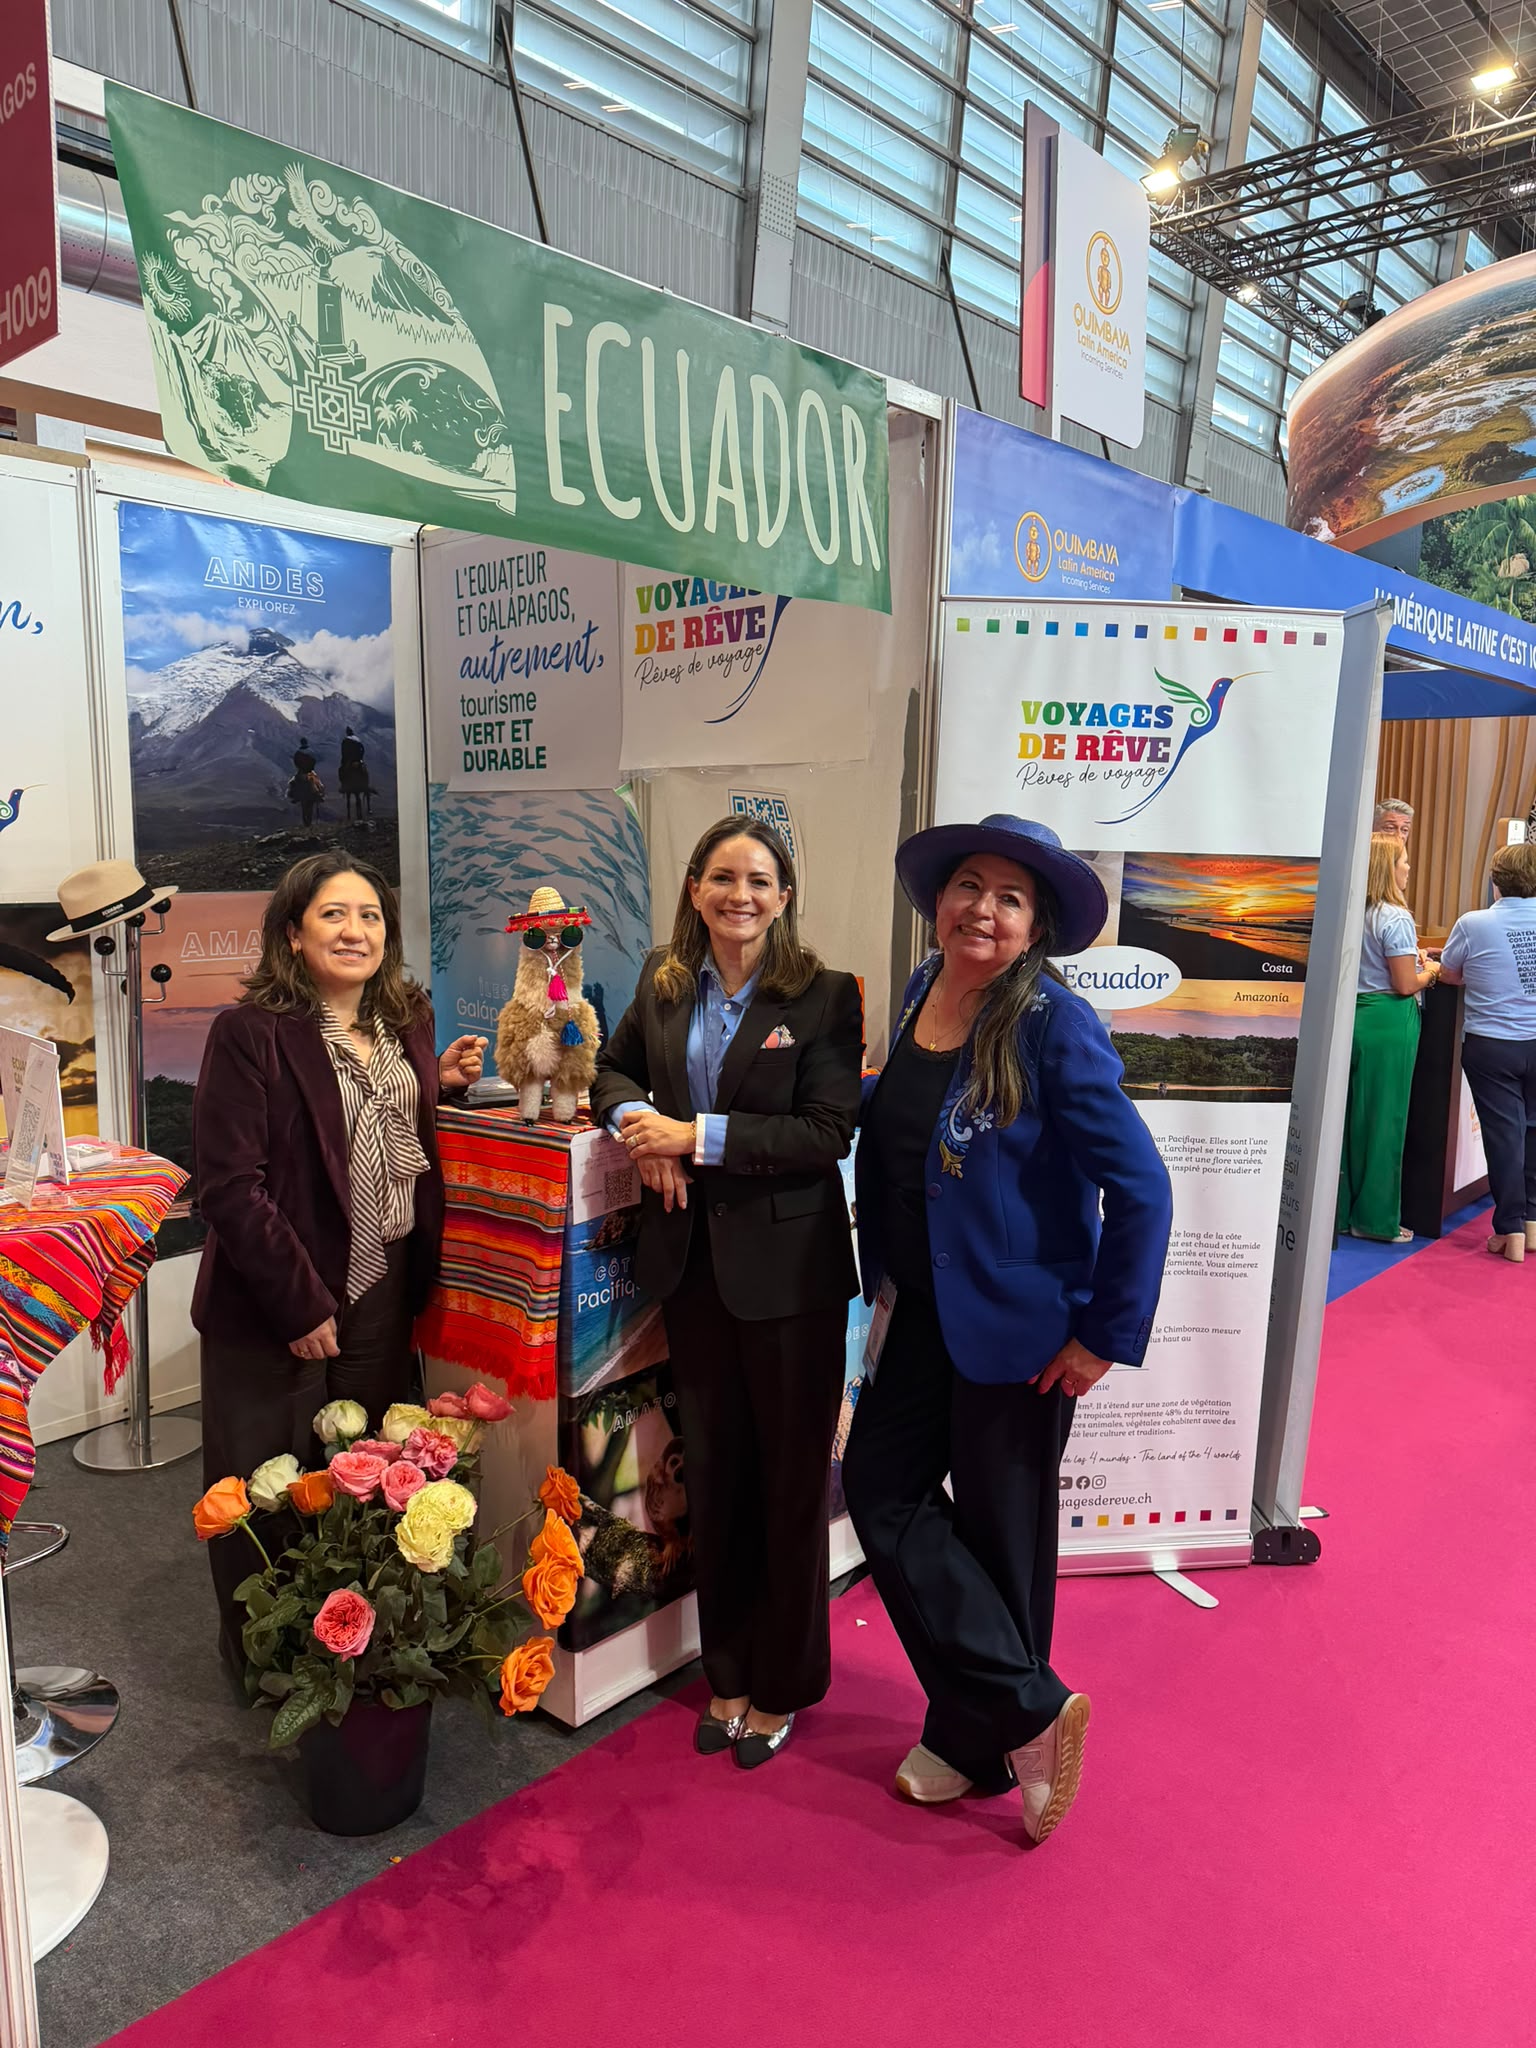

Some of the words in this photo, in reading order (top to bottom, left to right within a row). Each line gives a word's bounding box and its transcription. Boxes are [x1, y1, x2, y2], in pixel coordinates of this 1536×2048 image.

[1073, 302, 1132, 355] QUIMBAYA
[1077, 329, 1095, 351] Latin
[1096, 341, 1128, 369] America
[543, 302, 881, 571] ECUADOR
[1053, 529, 1119, 567] QUIMBAYA
[204, 556, 324, 597] ANDES
[456, 551, 547, 599] L'EQUATEUR
[1058, 555, 1078, 573] Latin
[1080, 561, 1115, 583] America
[1061, 574, 1089, 591] Incoming
[1088, 580, 1111, 594] Services
[238, 597, 296, 615] EXPLOREZ
[457, 604, 473, 637] ET
[478, 587, 575, 633] GALÁPAGOS,
[634, 620, 675, 655] DE
[683, 605, 765, 649] RÊVE
[459, 619, 604, 684] autrement,
[1456, 618, 1499, 657] LATINE
[1500, 633, 1527, 666] C'EST
[634, 656, 684, 691] Rêves
[688, 652, 703, 675] de
[707, 644, 765, 678] voyage
[460, 689, 537, 717] tourisme
[1021, 700, 1174, 729] VOYAGES
[461, 721, 505, 746] VERT
[511, 718, 533, 743] ET
[1017, 733, 1066, 760] DE
[1075, 729, 1171, 763] RÊVE
[463, 746, 547, 772] DURABLE
[1016, 762, 1074, 790] Rêves
[1079, 764, 1098, 783] de
[1103, 766, 1168, 790] voyage
[1062, 964, 1169, 990] Ecuador
[1261, 962, 1293, 974] Costa
[1233, 991, 1289, 1003] Amazonía
[1168, 1135, 1207, 1145] Pacifique.
[1209, 1137, 1228, 1145] Elles
[1164, 1145, 1203, 1154] L'archipel
[1216, 1147, 1241, 1155] trouve
[1250, 1148, 1267, 1156] près
[1211, 1156, 1231, 1165] flore
[1172, 1165, 1200, 1173] inspiré
[1202, 1167, 1222, 1175] pour
[1224, 1166, 1252, 1174] étudier
[1183, 1231, 1201, 1240] long
[1215, 1232, 1223, 1240] la
[1194, 1240, 1220, 1249] chaud
[1231, 1242, 1261, 1250] humide
[1206, 1260, 1225, 1268] Vous
[1208, 1251, 1229, 1259] vivre
[1173, 1268, 1208, 1277] cocktails
[1209, 1270, 1248, 1279] exotiques.
[1155, 1326, 1162, 1334] le
[1163, 1325, 1210, 1334] Chimborazo
[1163, 1335, 1180, 1343] haut
[1103, 1401, 1130, 1409] s'étend
[1191, 1399, 1232, 1408] végétation
[1124, 1410, 1163, 1419] représente
[1195, 1408, 1230, 1416] territoire
[1125, 1420, 1161, 1428] végétales
[1162, 1417, 1201, 1426] cohabitent
[1082, 1429, 1098, 1438] leur
[1099, 1429, 1126, 1437] culture
[1136, 1428, 1176, 1436] traditions.
[1073, 1455, 1087, 1465] los
[1089, 1451, 1098, 1465] 4
[1099, 1453, 1131, 1464] mundos
[1139, 1448, 1155, 1462] The
[1157, 1451, 1176, 1461] land
[1178, 1449, 1187, 1461] of
[1188, 1448, 1202, 1459] the
[1203, 1446, 1212, 1458] 4
[1213, 1449, 1242, 1461] worlds
